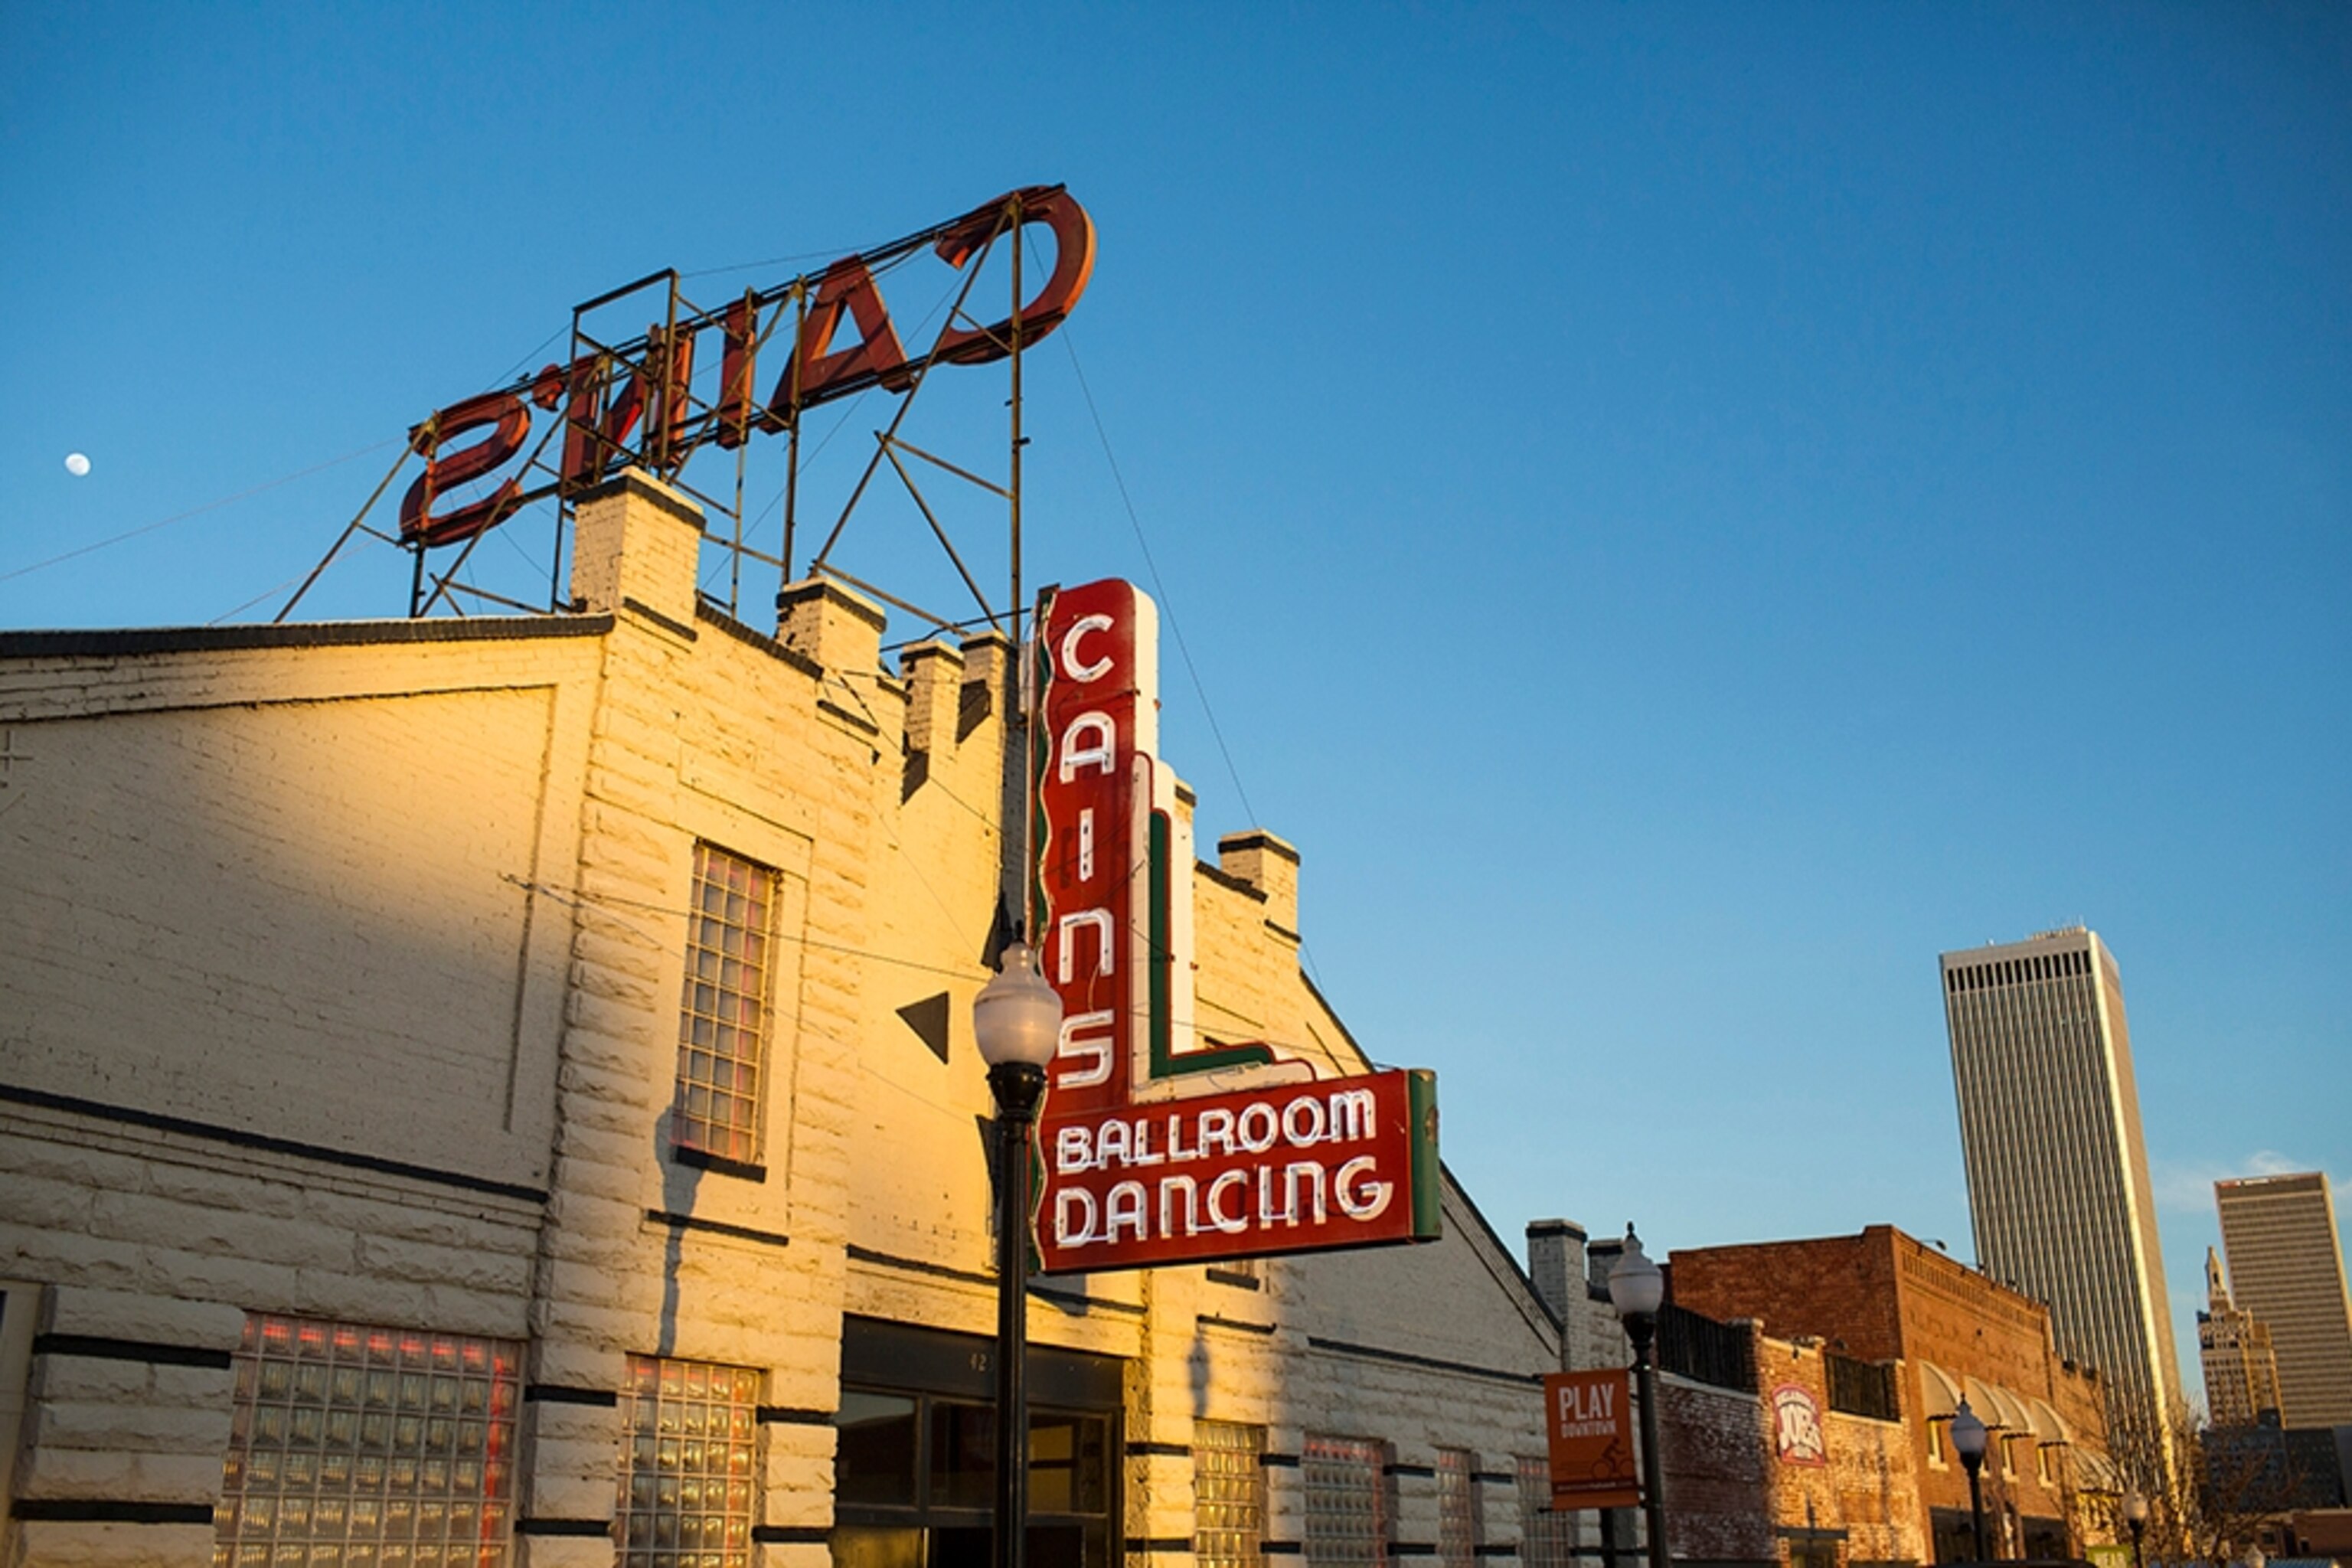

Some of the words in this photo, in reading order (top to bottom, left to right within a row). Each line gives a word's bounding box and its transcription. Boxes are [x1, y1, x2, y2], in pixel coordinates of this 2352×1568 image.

[1055, 1088, 1377, 1175] BALLROOM
[1054, 1156, 1393, 1249] DANCING
[1558, 1383, 1615, 1421] PLAY
